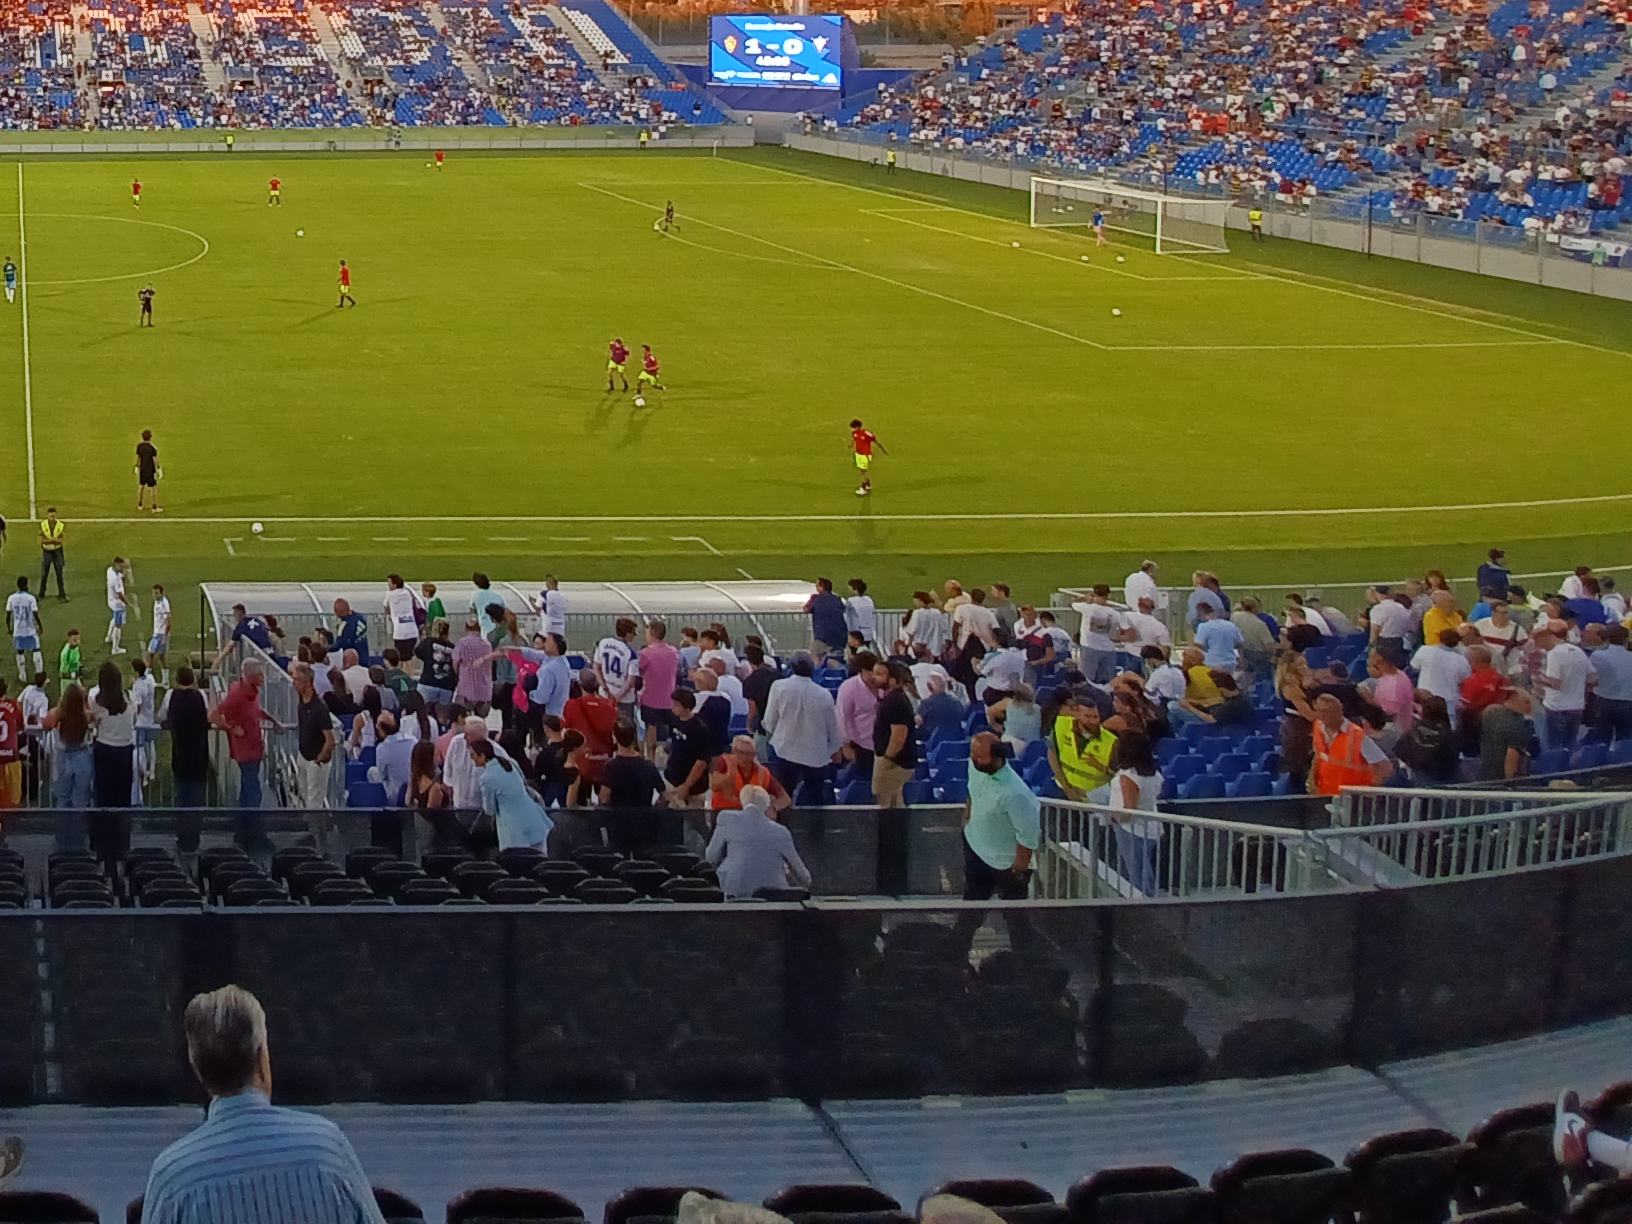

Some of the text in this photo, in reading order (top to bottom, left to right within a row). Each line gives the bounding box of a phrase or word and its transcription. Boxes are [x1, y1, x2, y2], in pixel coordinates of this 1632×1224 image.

[745, 38, 762, 54] 1
[783, 38, 804, 55] 0
[602, 652, 623, 678] 14
